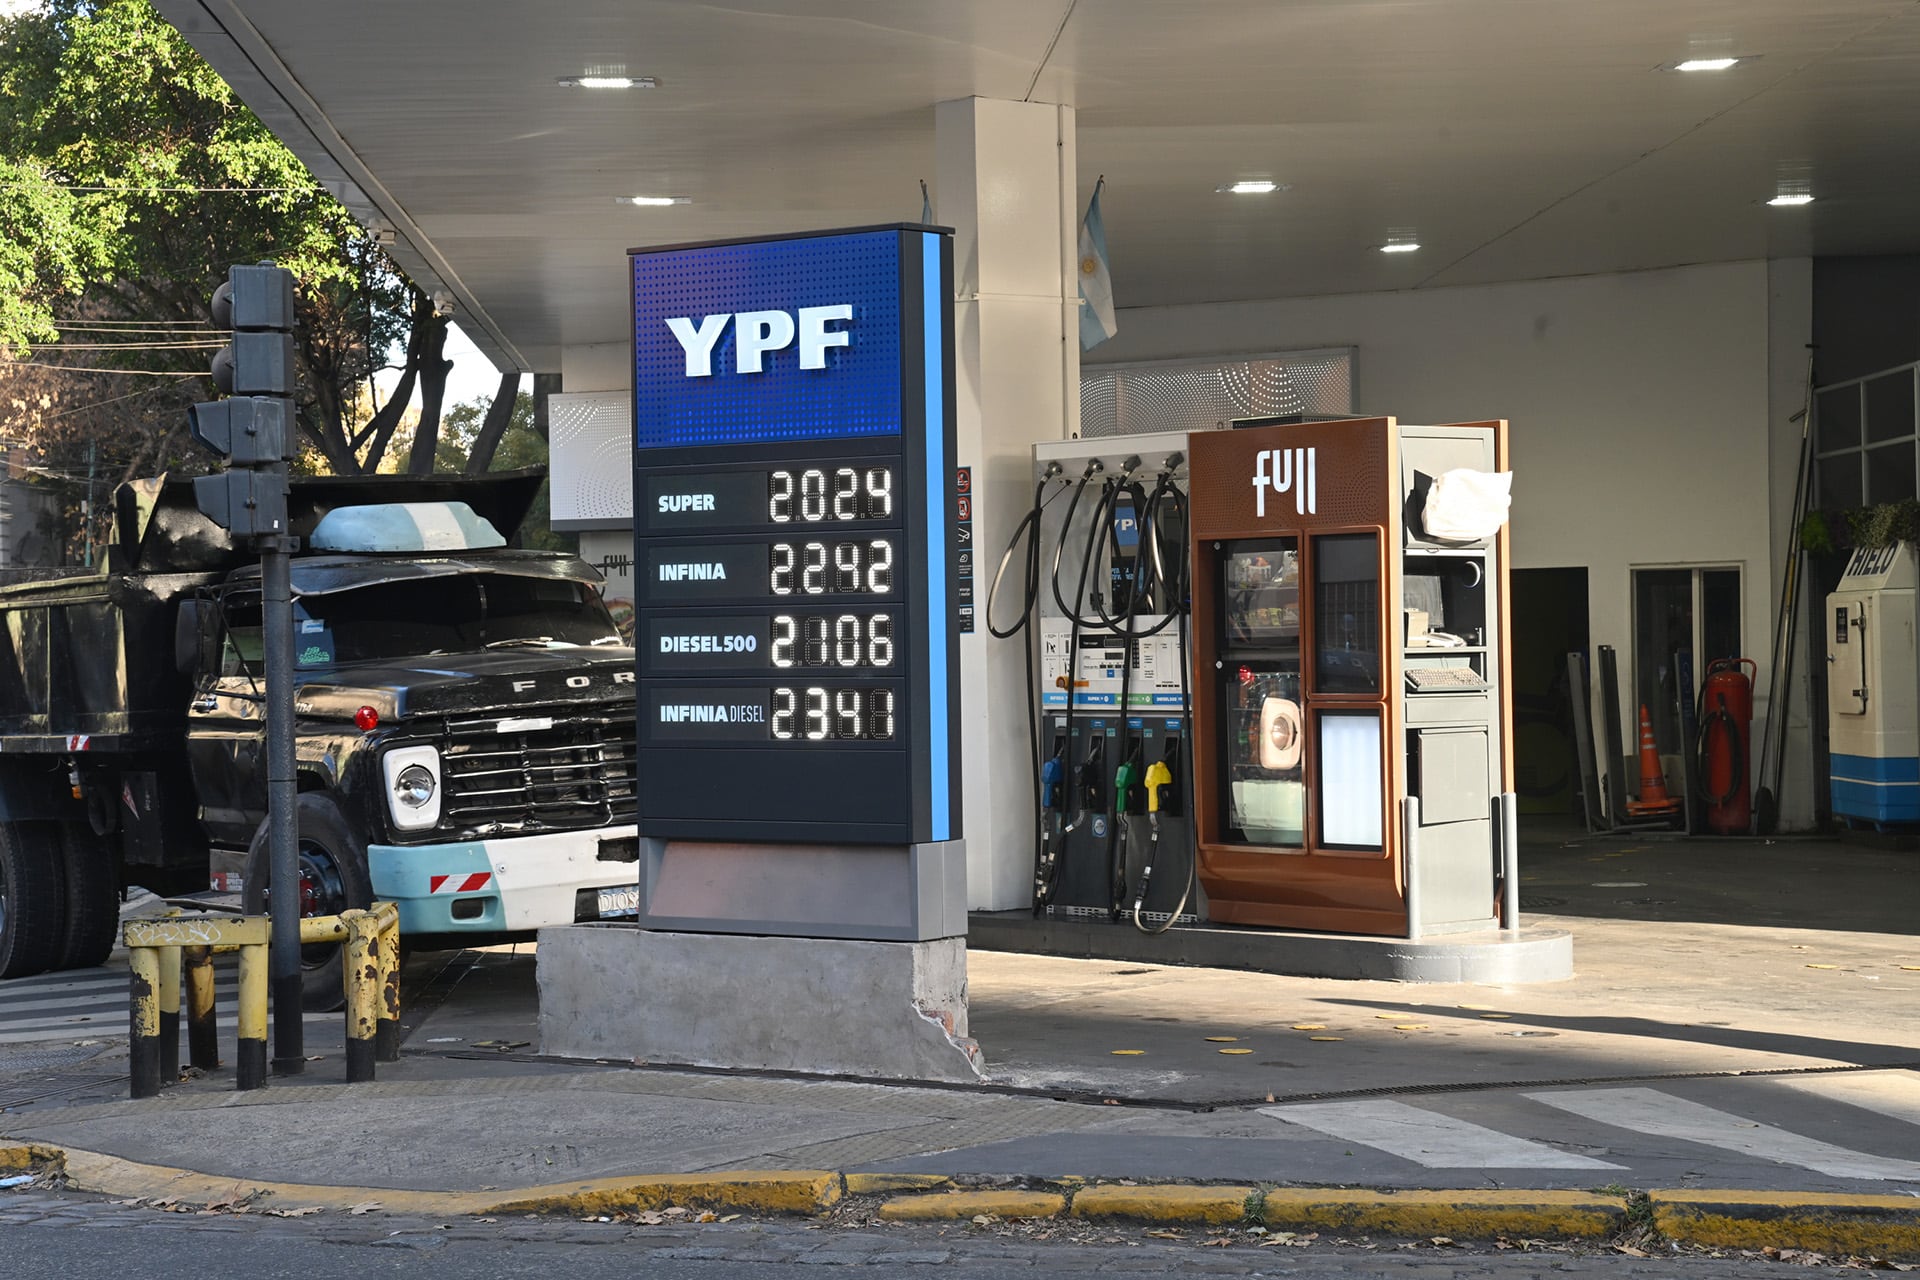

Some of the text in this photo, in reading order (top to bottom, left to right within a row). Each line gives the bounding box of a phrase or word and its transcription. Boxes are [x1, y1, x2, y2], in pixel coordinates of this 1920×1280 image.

[664, 304, 853, 377] YPF
[658, 468, 891, 522] SUPER 2024
[659, 540, 892, 594] INFINIA 2242
[1847, 540, 1899, 576] HIELO
[660, 615, 894, 668] DIESEL 500 2106
[512, 672, 636, 692] FOR
[660, 688, 894, 739] INFINIA DIESEL 2341
